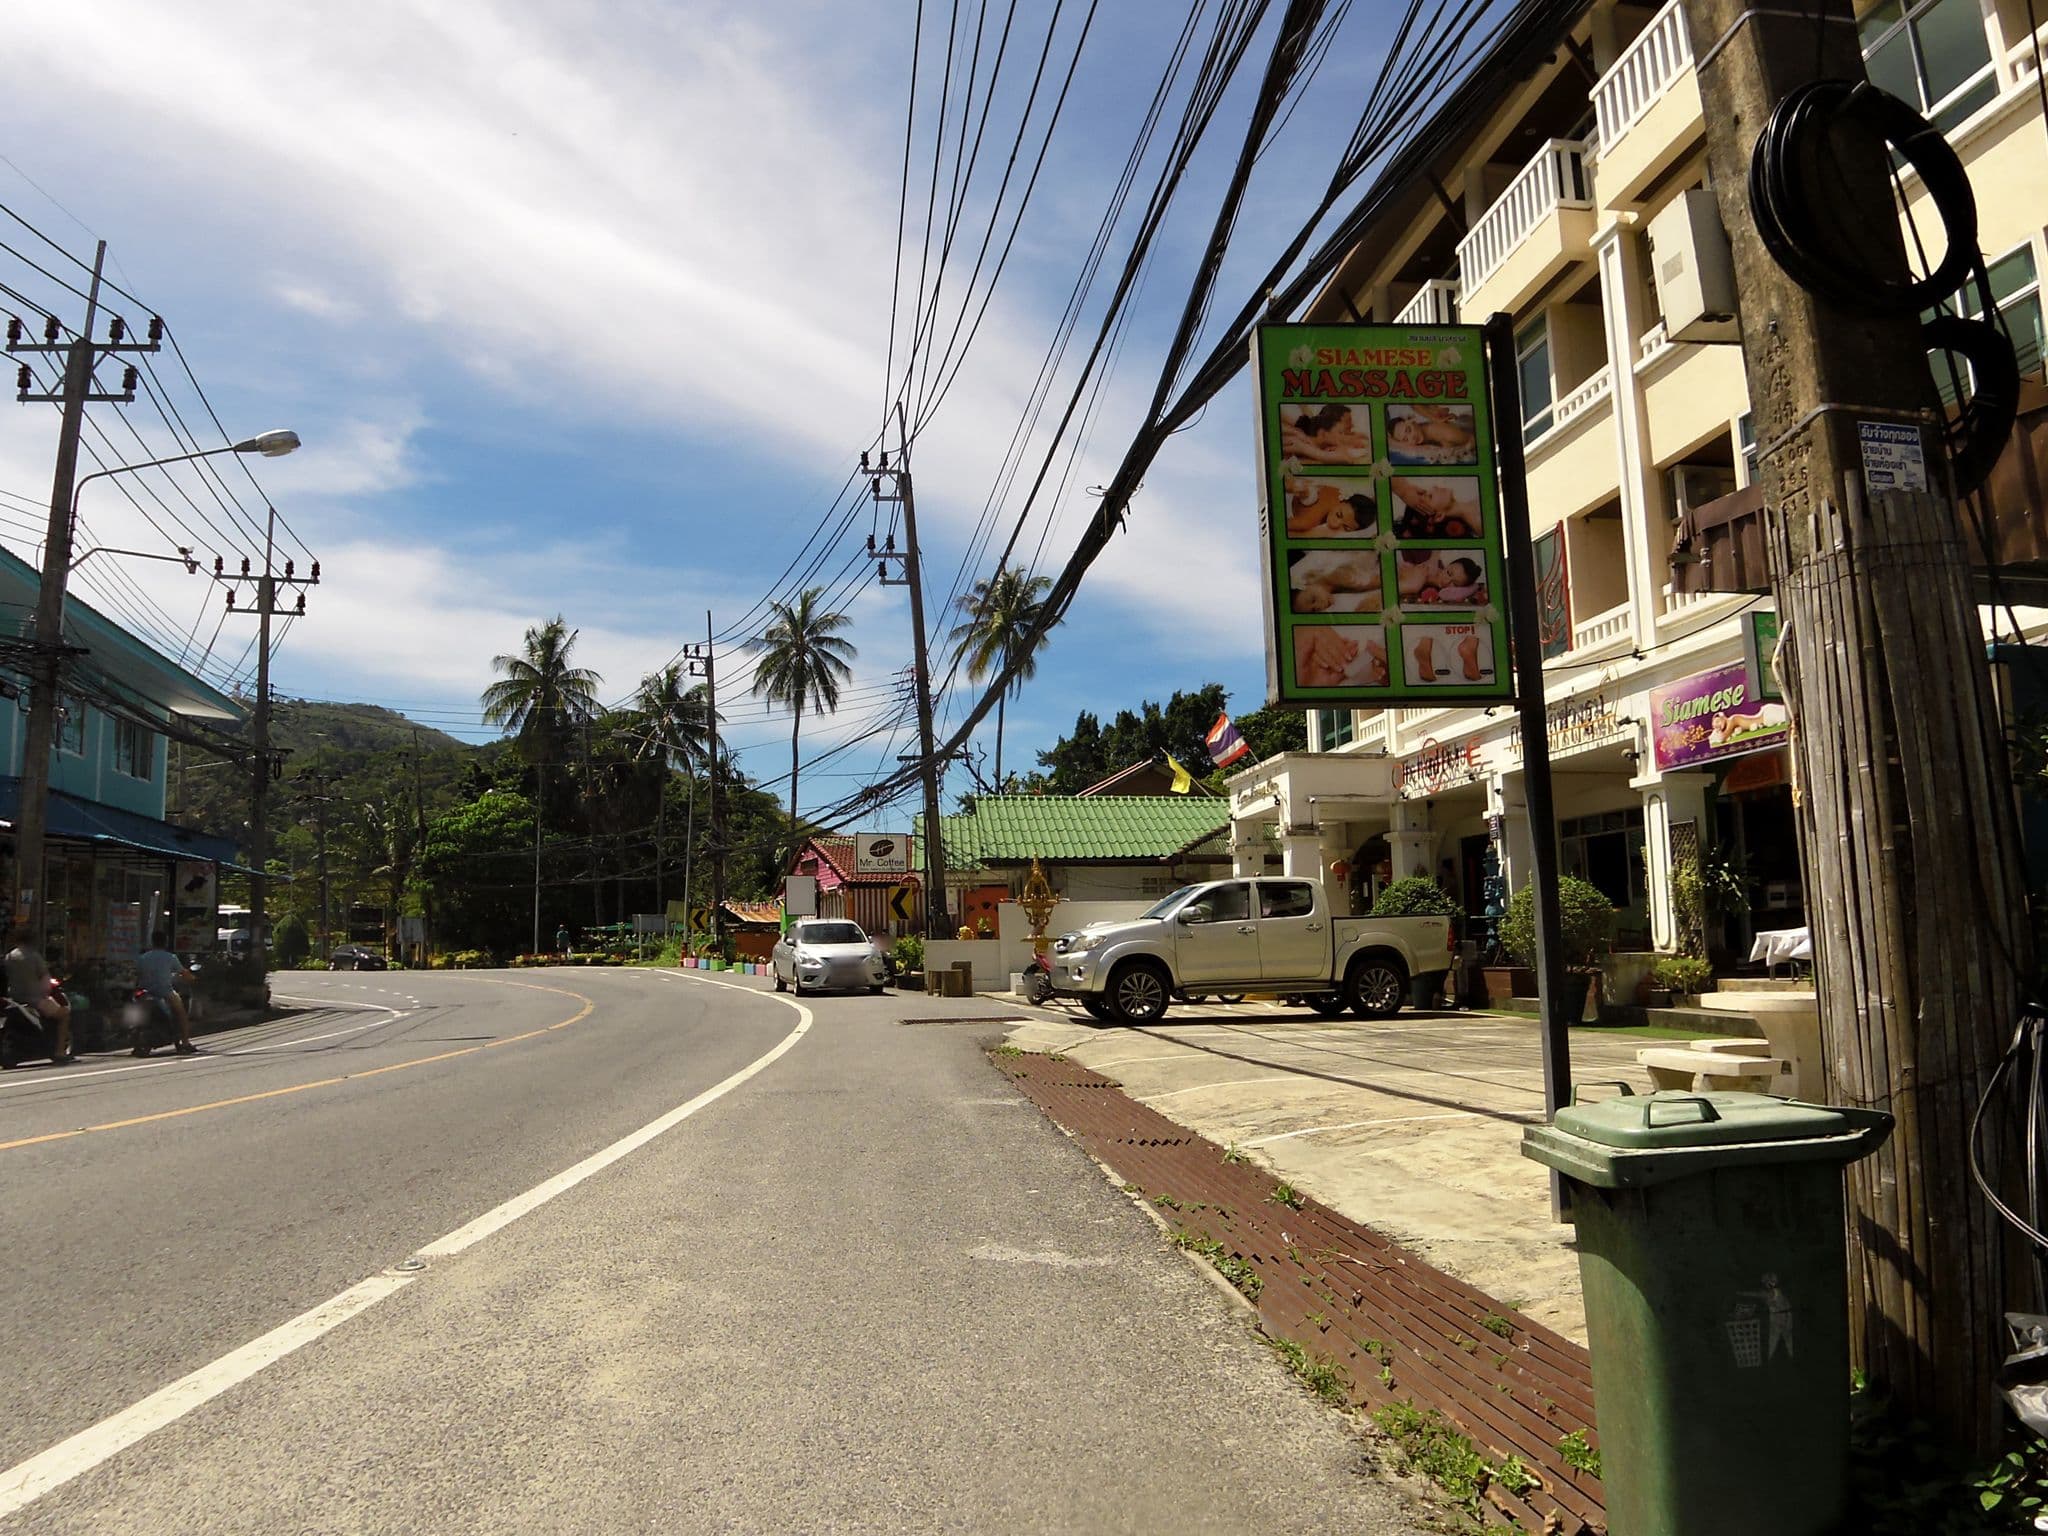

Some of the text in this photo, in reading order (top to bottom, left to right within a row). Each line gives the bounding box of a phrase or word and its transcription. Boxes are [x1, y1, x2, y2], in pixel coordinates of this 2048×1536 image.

[1317, 349, 1432, 366] SIAMESE
[1281, 368, 1468, 399] MASSAGE
[1660, 684, 1745, 728] Siamese
[877, 858, 904, 867] Coffee
